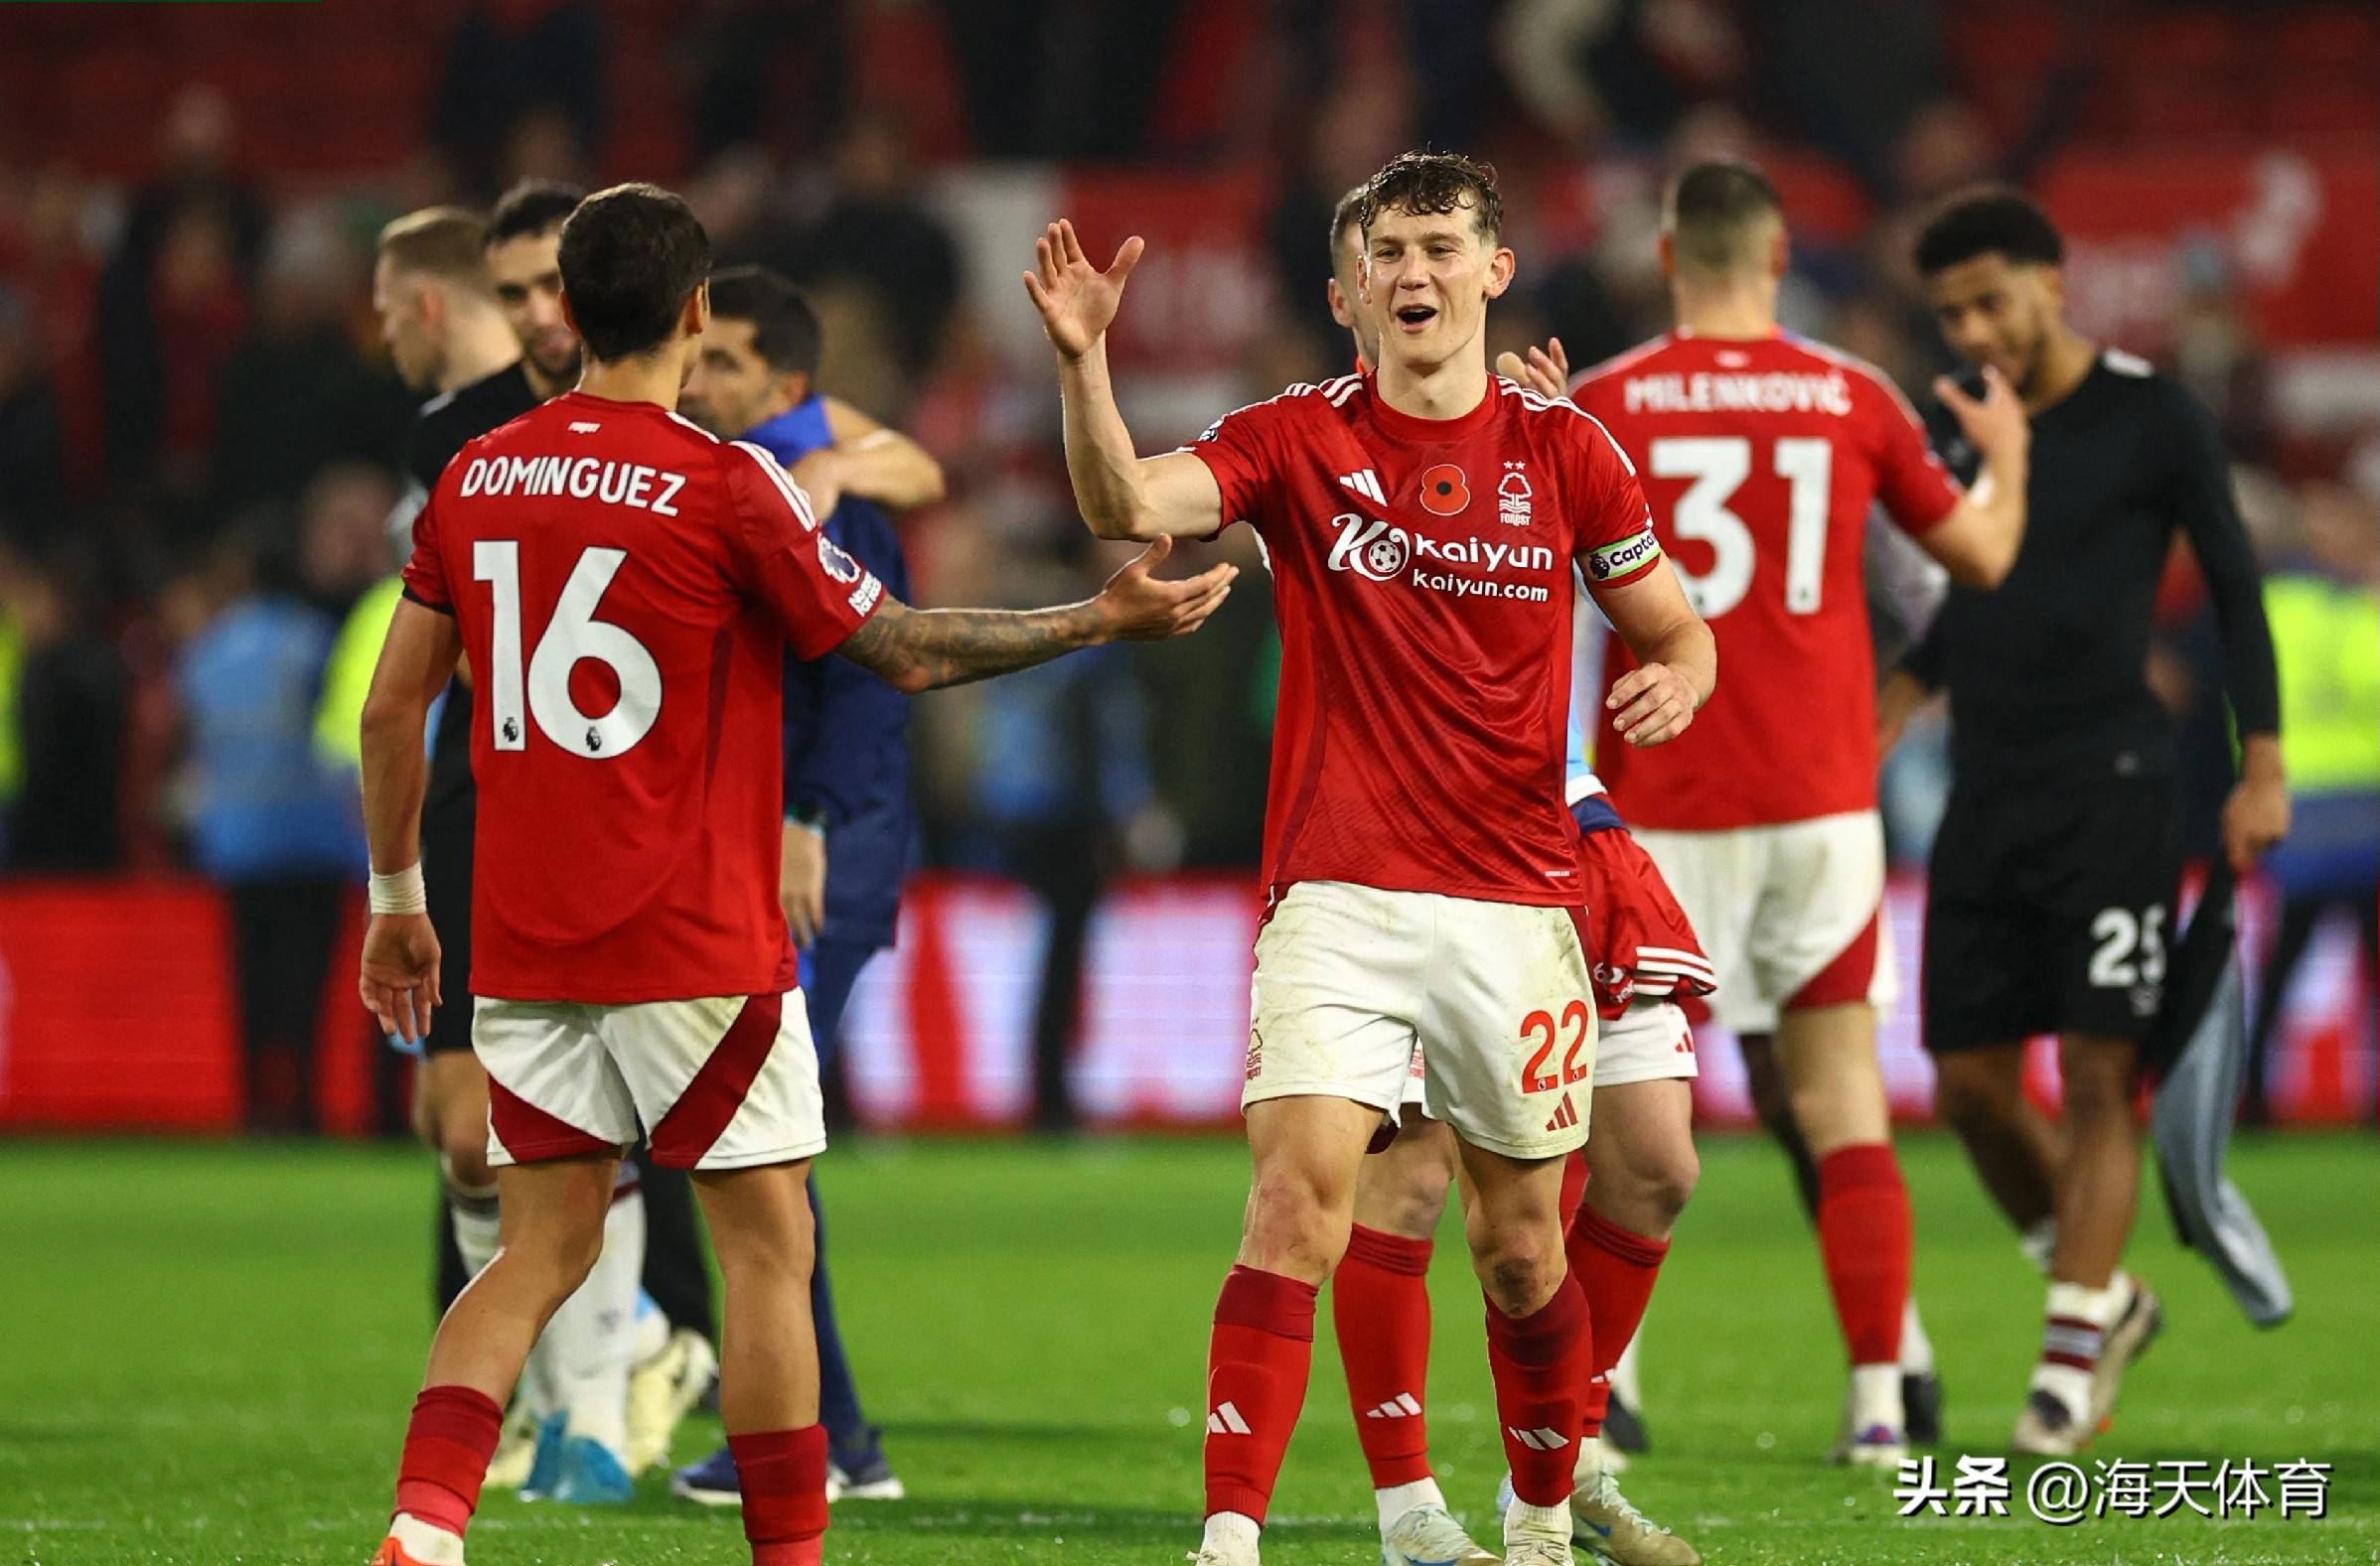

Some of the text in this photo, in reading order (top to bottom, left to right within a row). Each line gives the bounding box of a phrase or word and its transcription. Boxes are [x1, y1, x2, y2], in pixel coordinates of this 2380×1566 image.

[1624, 368, 1854, 415] MILENKOVIĆ
[460, 456, 686, 516] DOMINGUEZ
[1500, 512, 1532, 526] FOREST
[1649, 436, 1832, 620] 31
[1414, 532, 1554, 572] kaiyun
[1413, 569, 1549, 602] kaiyun.com
[473, 540, 663, 759] 16
[1520, 1000, 1588, 1093] 22
